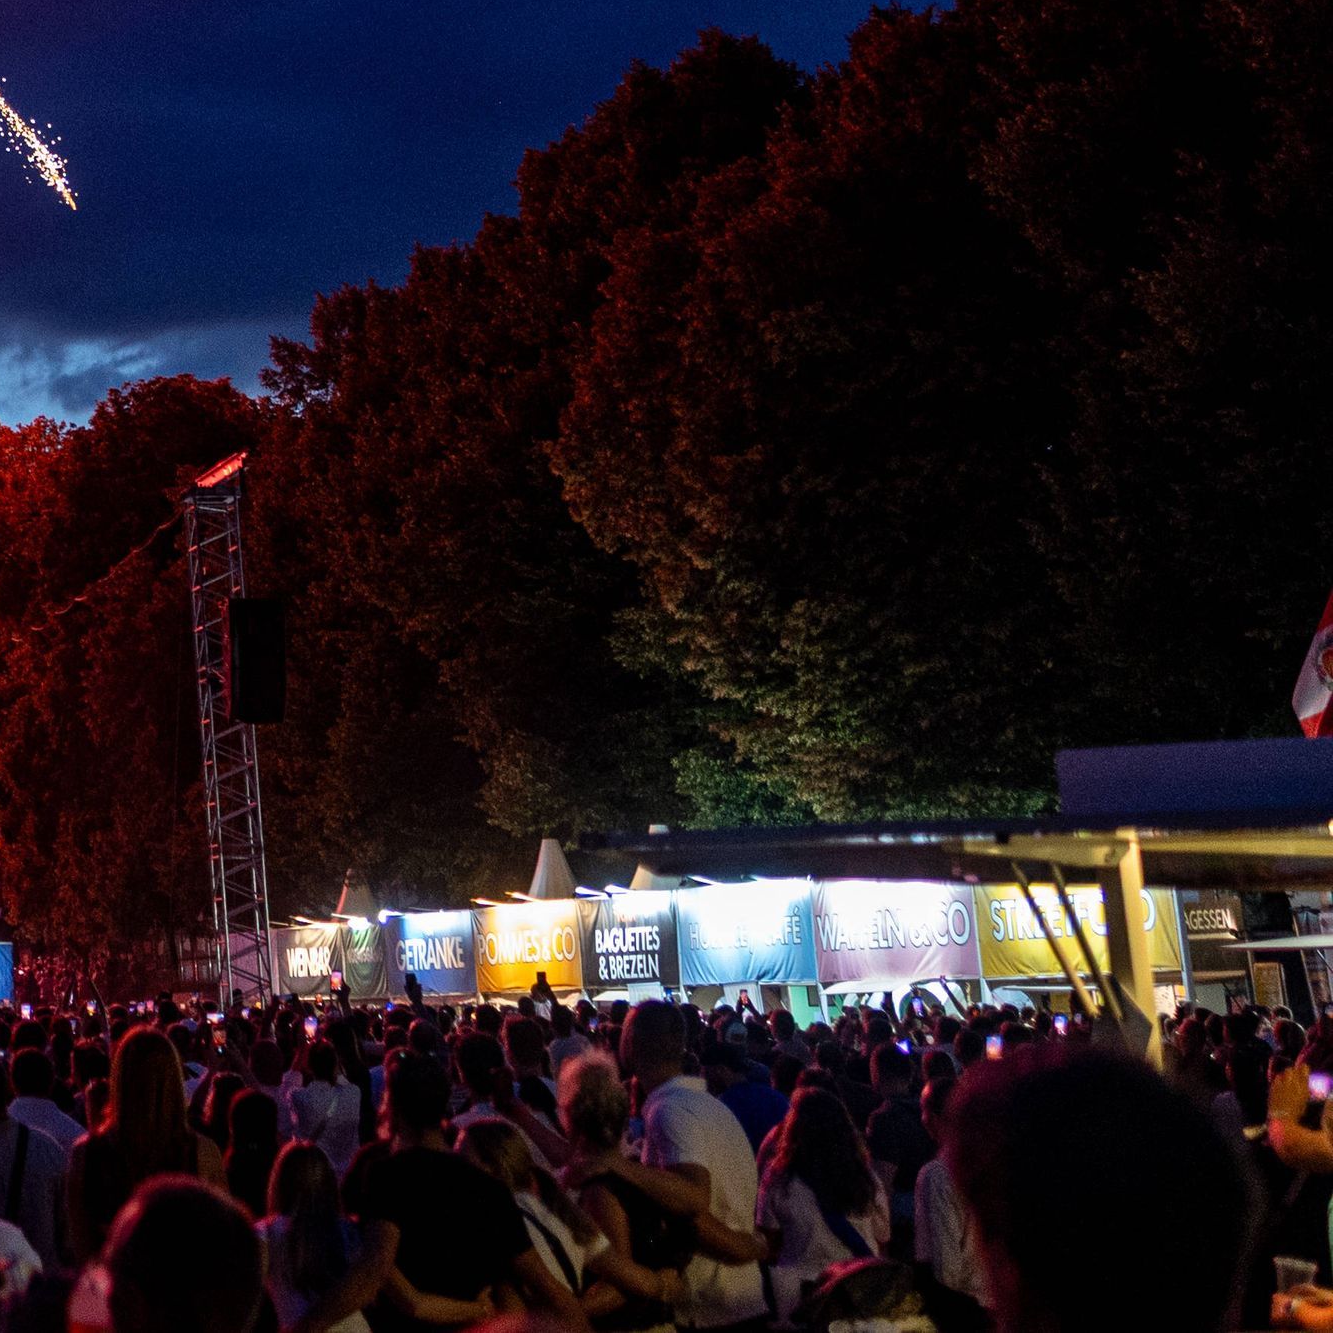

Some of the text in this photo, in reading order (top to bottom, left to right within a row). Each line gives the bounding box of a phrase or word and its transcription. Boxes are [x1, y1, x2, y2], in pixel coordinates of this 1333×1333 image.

[595, 925, 660, 954] BAGUETTES
[932, 899, 971, 947] CO
[477, 929, 541, 965] POMMES
[552, 926, 576, 961] CO
[598, 954, 661, 980] & BREZELN
